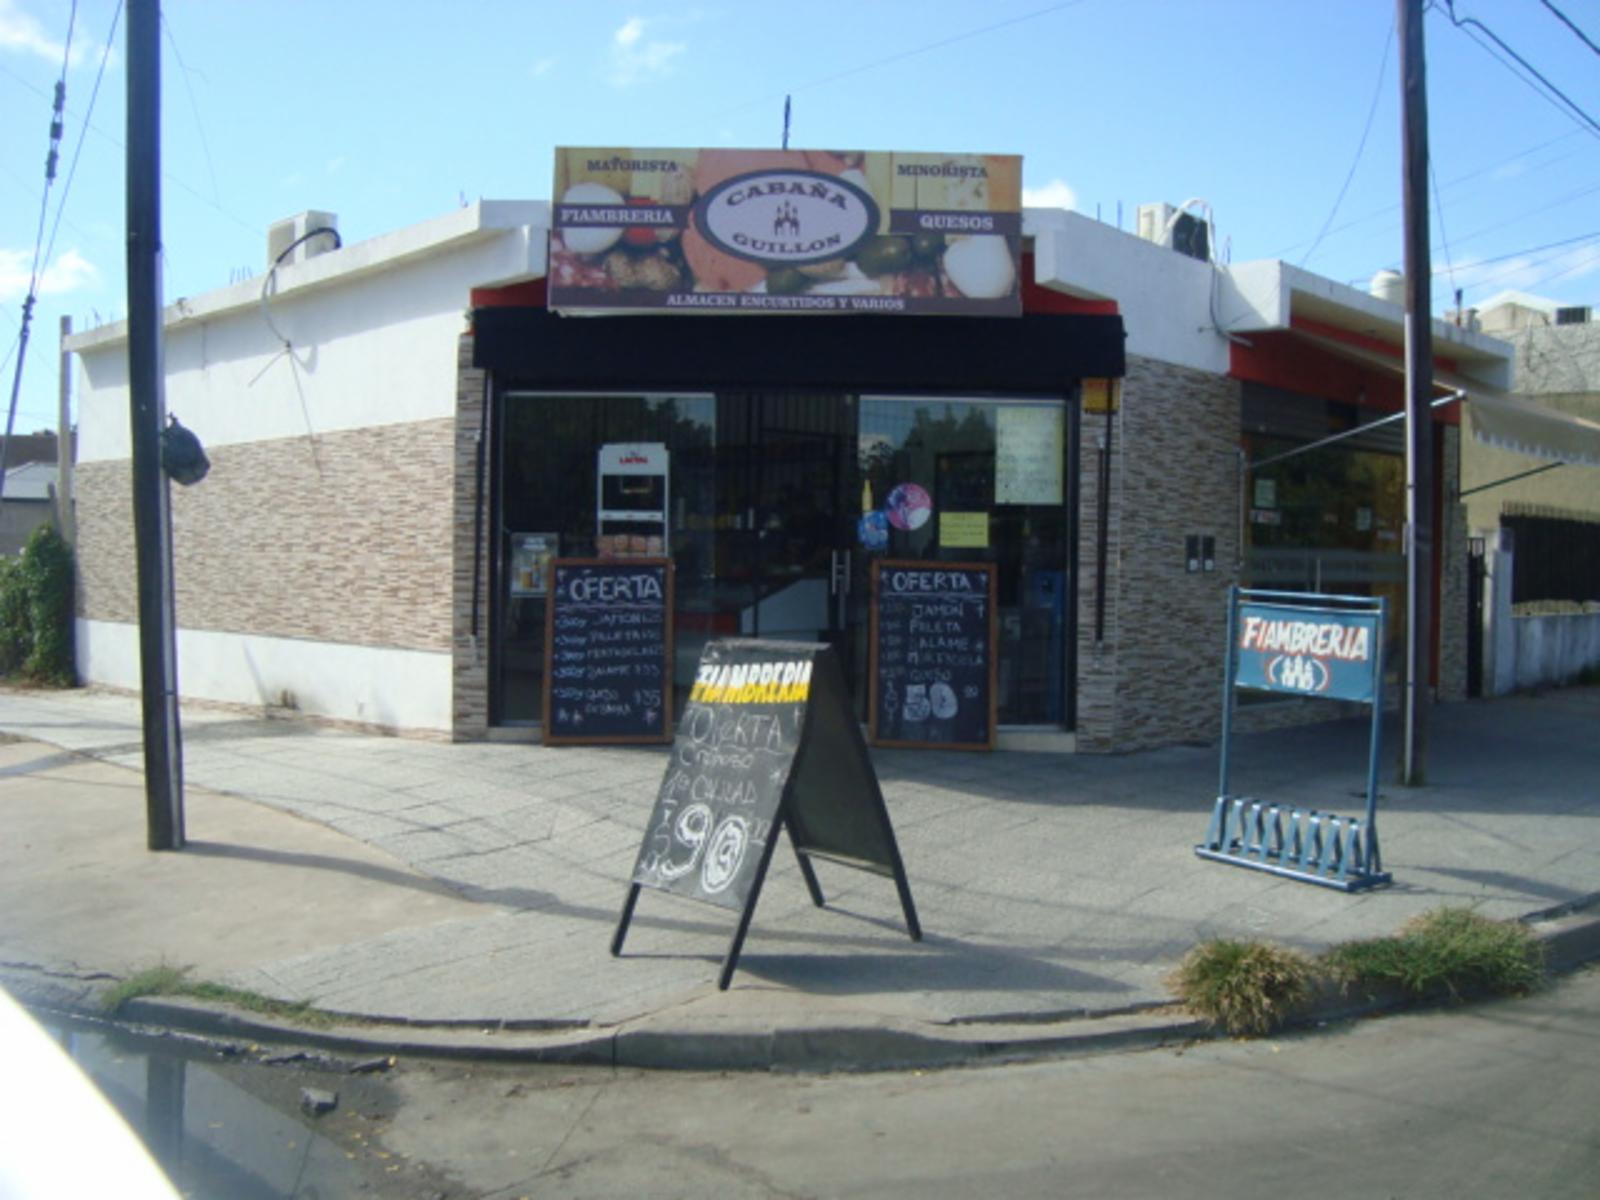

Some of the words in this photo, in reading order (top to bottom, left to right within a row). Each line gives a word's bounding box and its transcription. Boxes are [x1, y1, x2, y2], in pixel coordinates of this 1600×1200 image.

[587, 157, 678, 172] MAYORISTA
[897, 164, 988, 178] MINORISTA
[726, 181, 848, 210] CABAÑA
[561, 207, 674, 224] FIAMBRERIA
[920, 214, 994, 230] QUESOS
[732, 231, 842, 254] GUILLON
[667, 293, 736, 306] ALMACEN
[740, 293, 835, 308] ENCURTIDOS
[838, 296, 849, 308] Y
[851, 297, 905, 310] VARIOS
[569, 573, 663, 601] OFERTA
[892, 571, 972, 592] OFERTA
[1240, 615, 1369, 661] FIAMBRERIA
[688, 660, 813, 703] FIAMBRERIA
[902, 682, 959, 722] 50
[658, 803, 749, 893] 90
